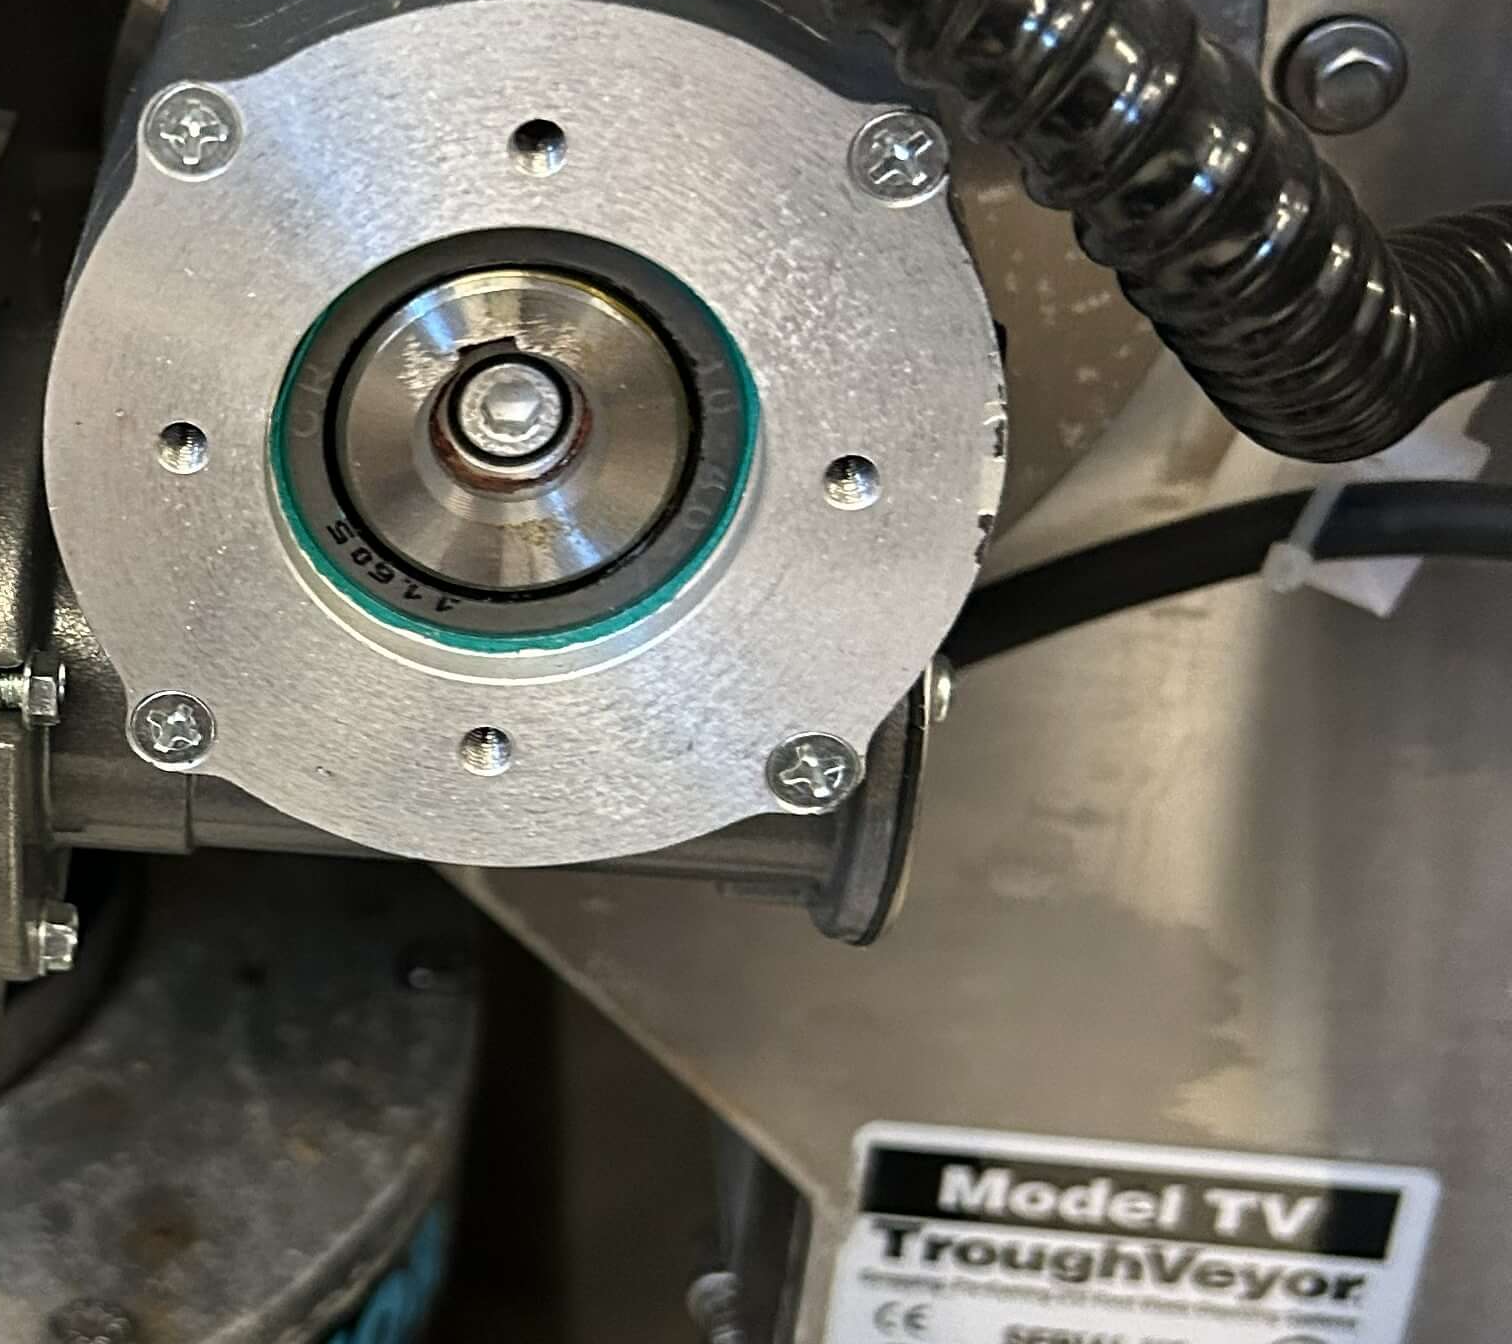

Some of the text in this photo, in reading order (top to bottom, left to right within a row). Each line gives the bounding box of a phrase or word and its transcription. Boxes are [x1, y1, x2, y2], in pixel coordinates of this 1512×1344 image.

[936, 1163, 1323, 1242] Model TV
[872, 1218, 1368, 1302] TroughVeyor
